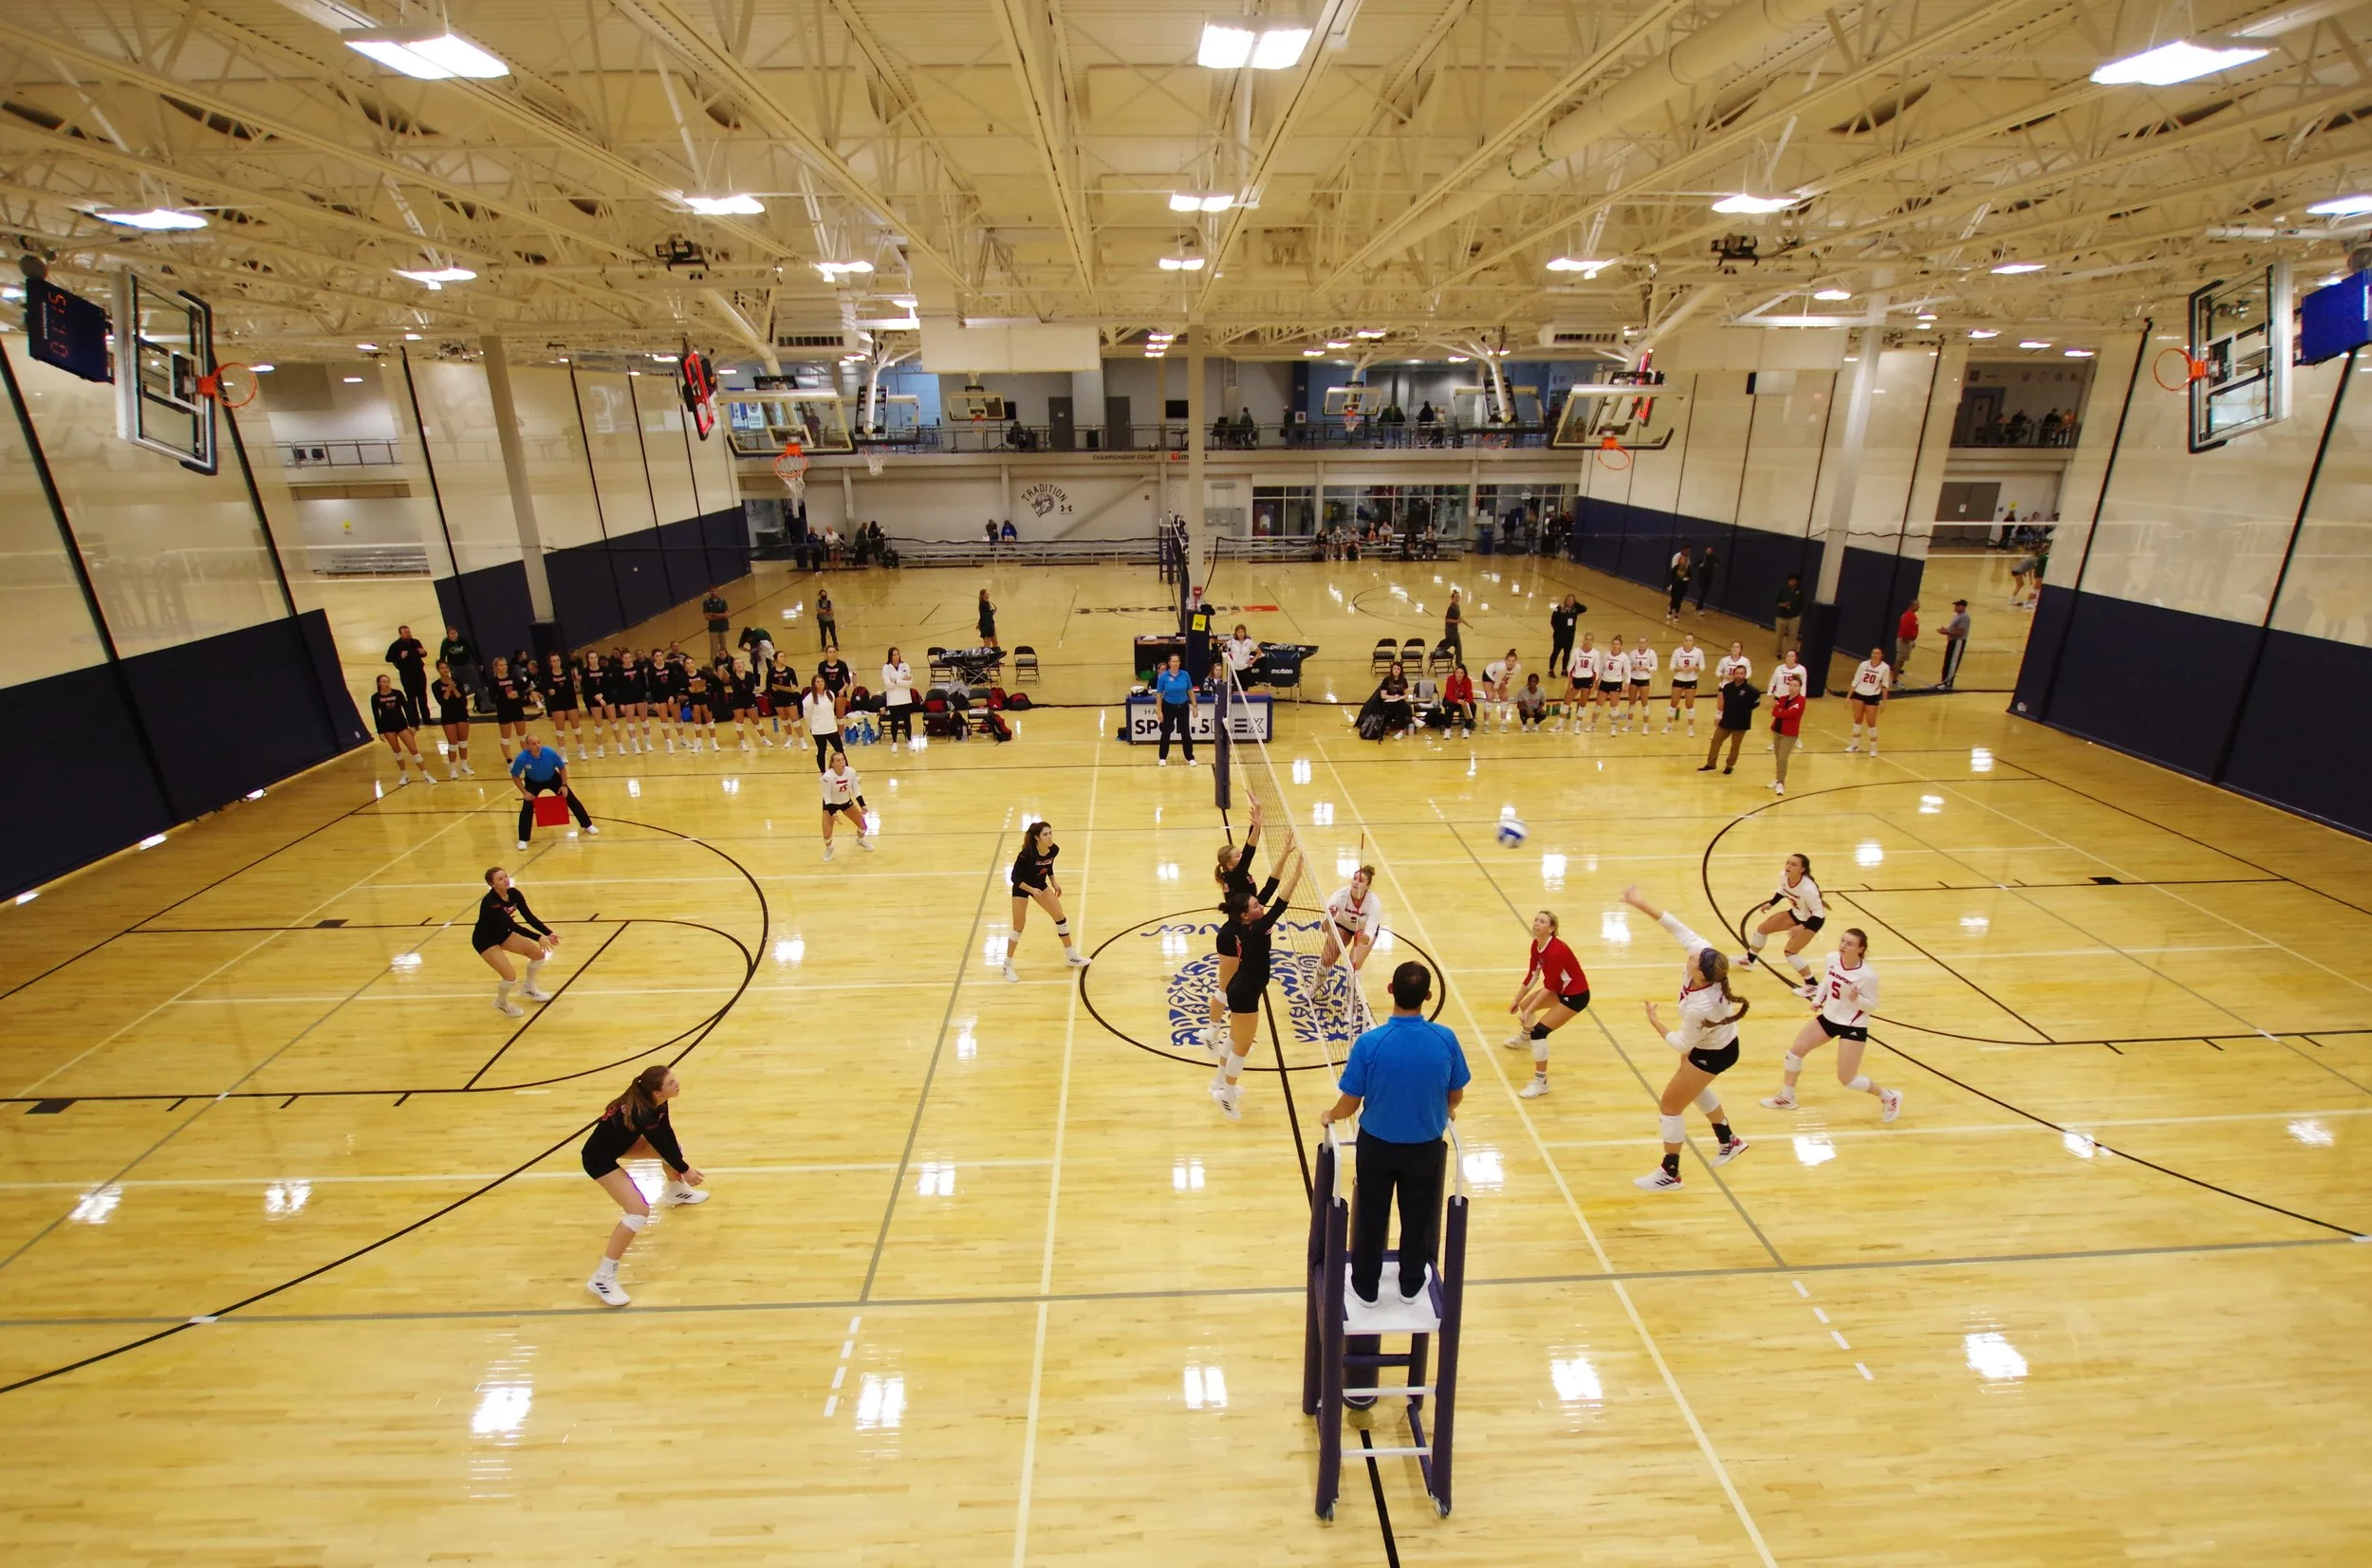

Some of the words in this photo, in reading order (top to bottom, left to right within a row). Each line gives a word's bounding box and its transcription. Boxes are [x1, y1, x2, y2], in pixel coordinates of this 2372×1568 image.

[1021, 483, 1068, 502] TRADITION
[1862, 673, 1877, 684] 20
[1831, 980, 1842, 1000] 5
